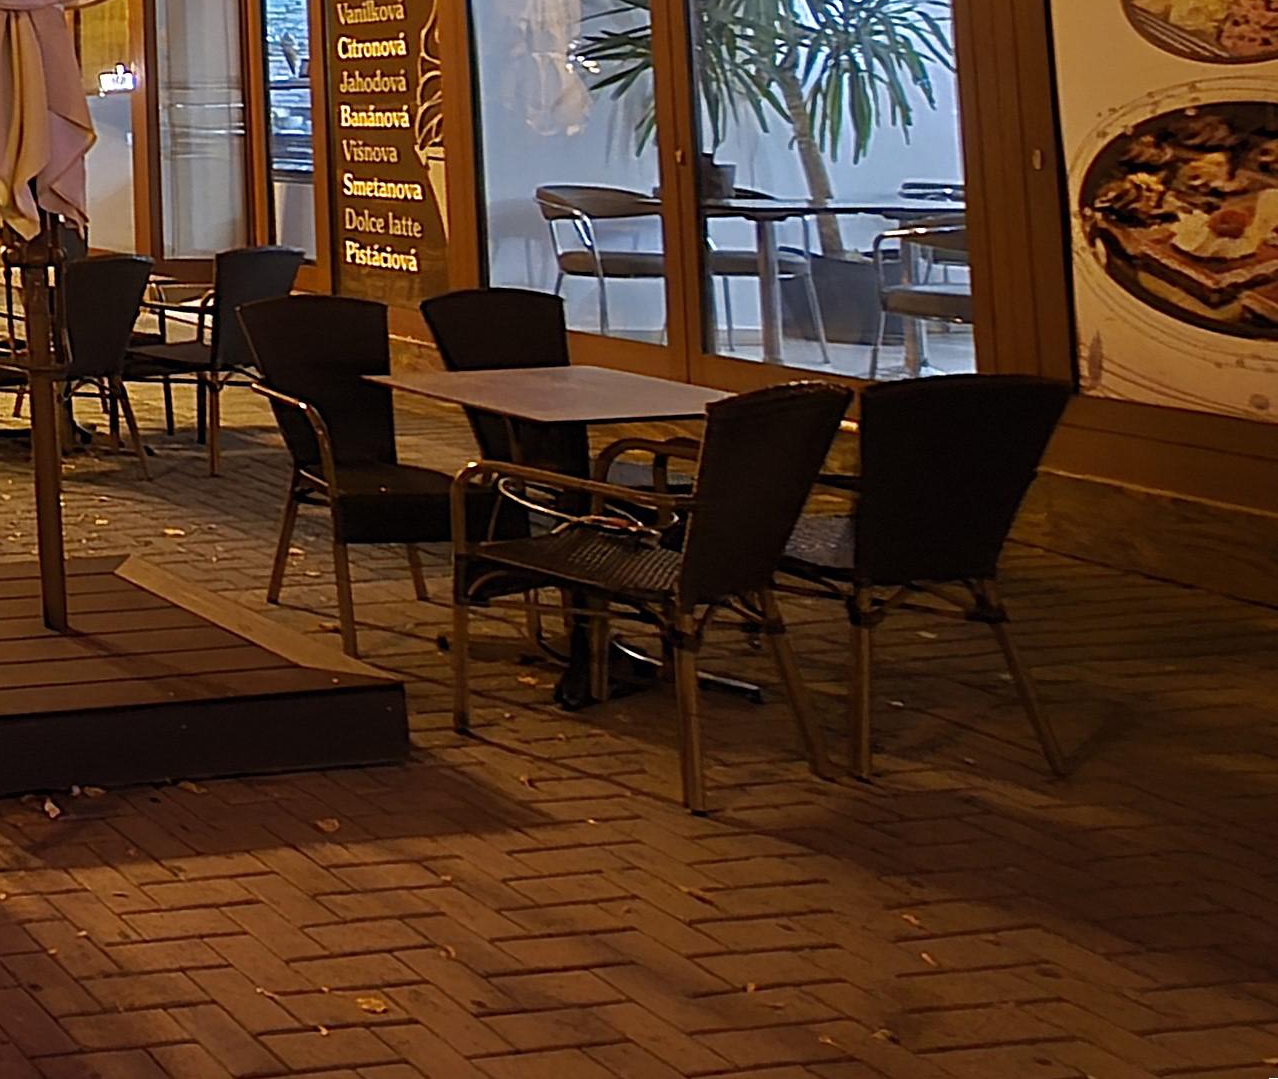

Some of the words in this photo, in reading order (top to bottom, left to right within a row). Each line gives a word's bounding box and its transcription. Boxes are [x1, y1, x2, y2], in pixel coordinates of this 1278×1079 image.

[337, 32, 407, 59] Citronová
[339, 69, 407, 93] Jahodová
[340, 104, 411, 128] Banánová
[344, 207, 385, 234] Dolce
[388, 212, 423, 238] latte
[345, 240, 419, 272] Pistáciová
